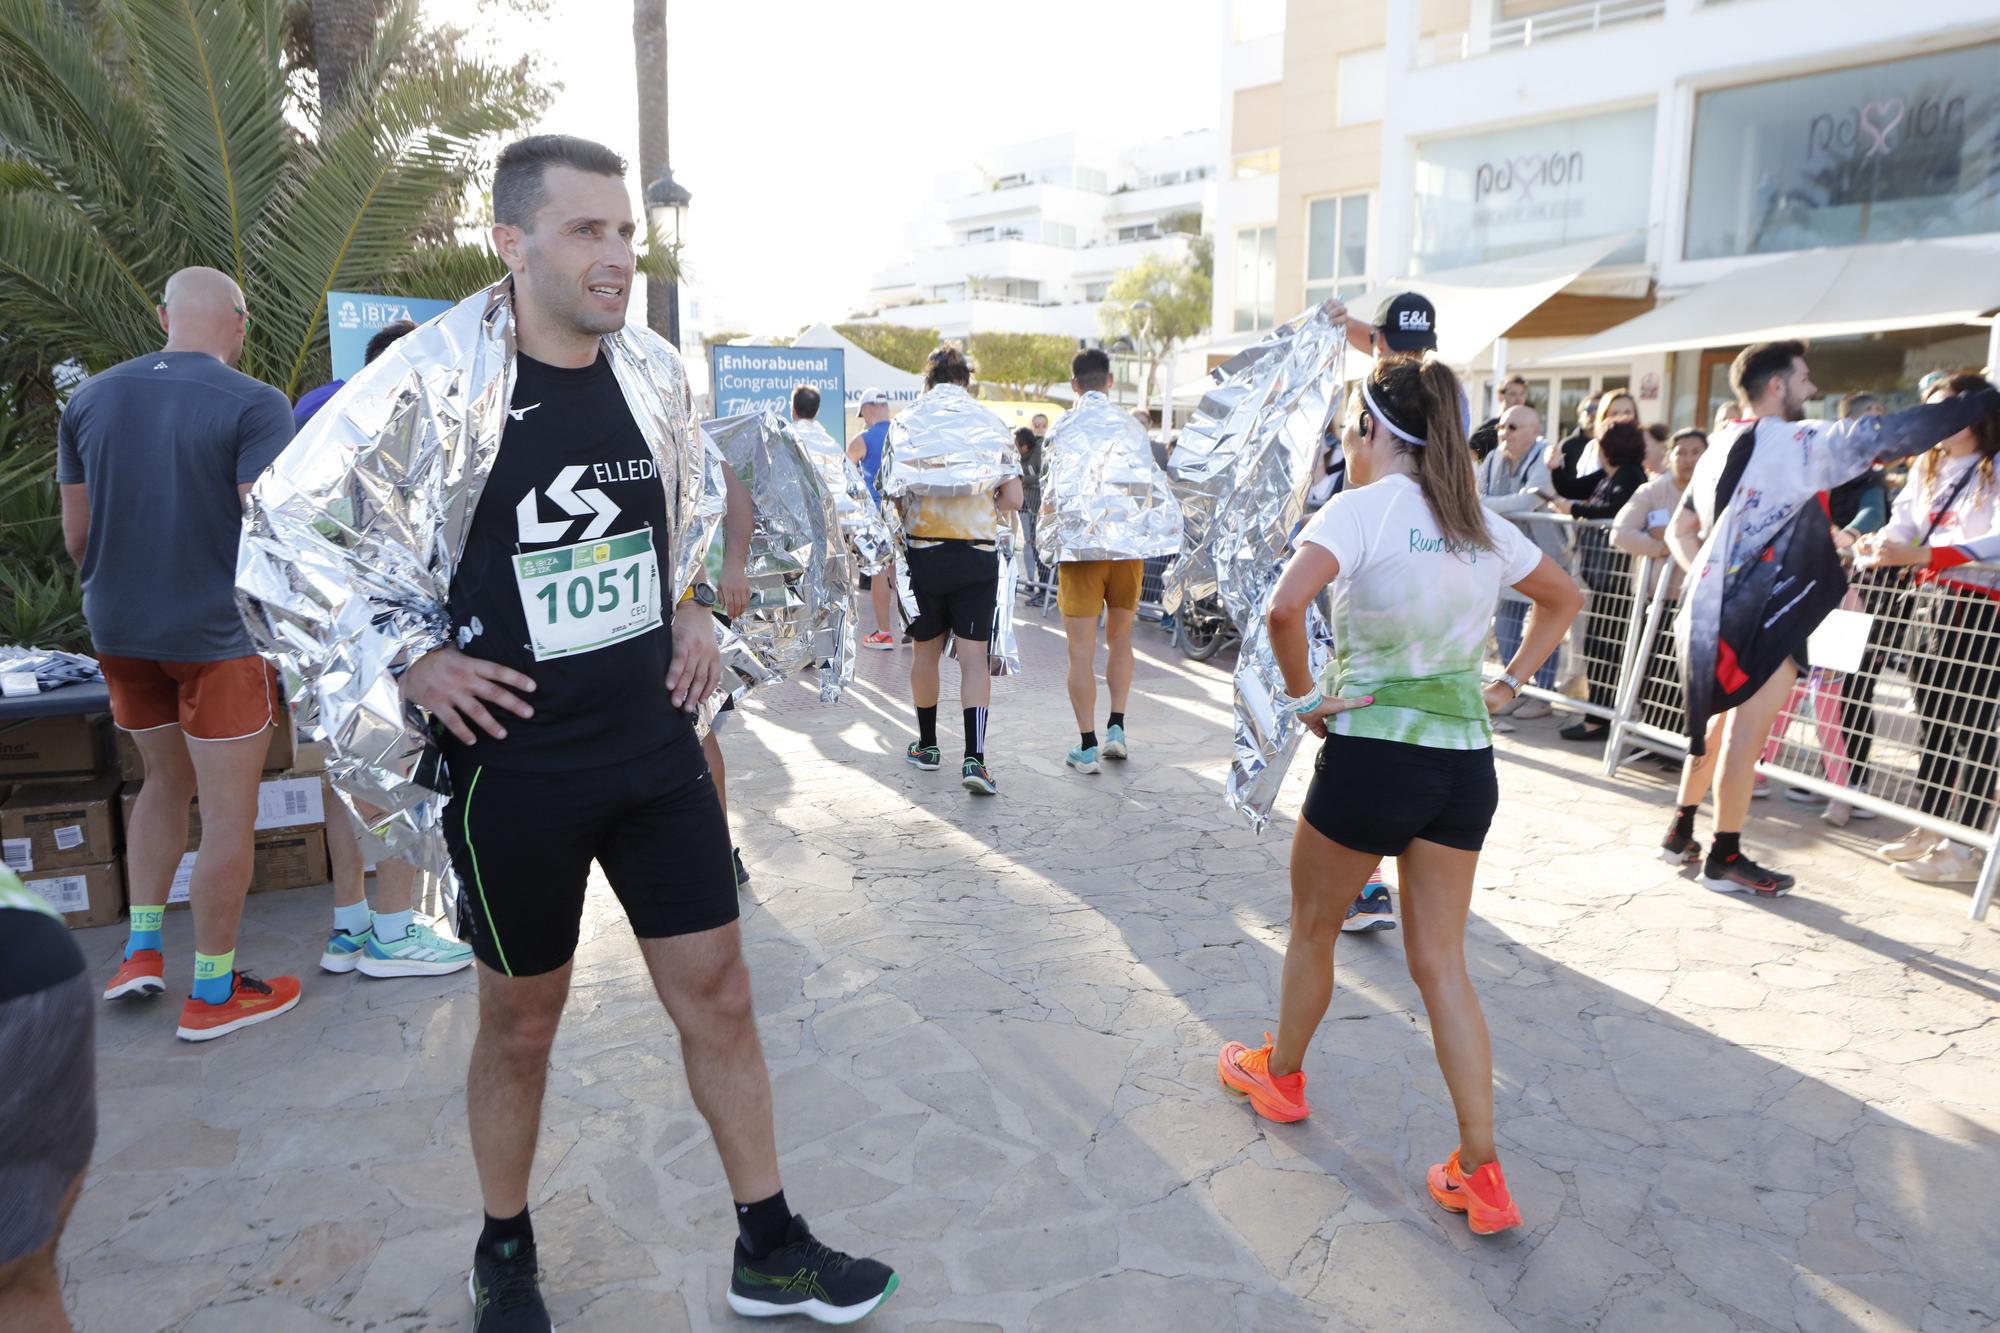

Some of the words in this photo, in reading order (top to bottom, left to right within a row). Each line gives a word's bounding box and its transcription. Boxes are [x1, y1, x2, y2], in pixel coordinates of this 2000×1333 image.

[361, 305, 412, 322] IBIZA
[1399, 310, 1430, 326] E&L
[719, 355, 828, 372] ¡Enhorabuena!
[720, 374, 838, 392] ¡Congratulations!
[886, 390, 922, 401] LINIC
[593, 459, 658, 483] ELLEDI
[536, 562, 640, 625] 1051
